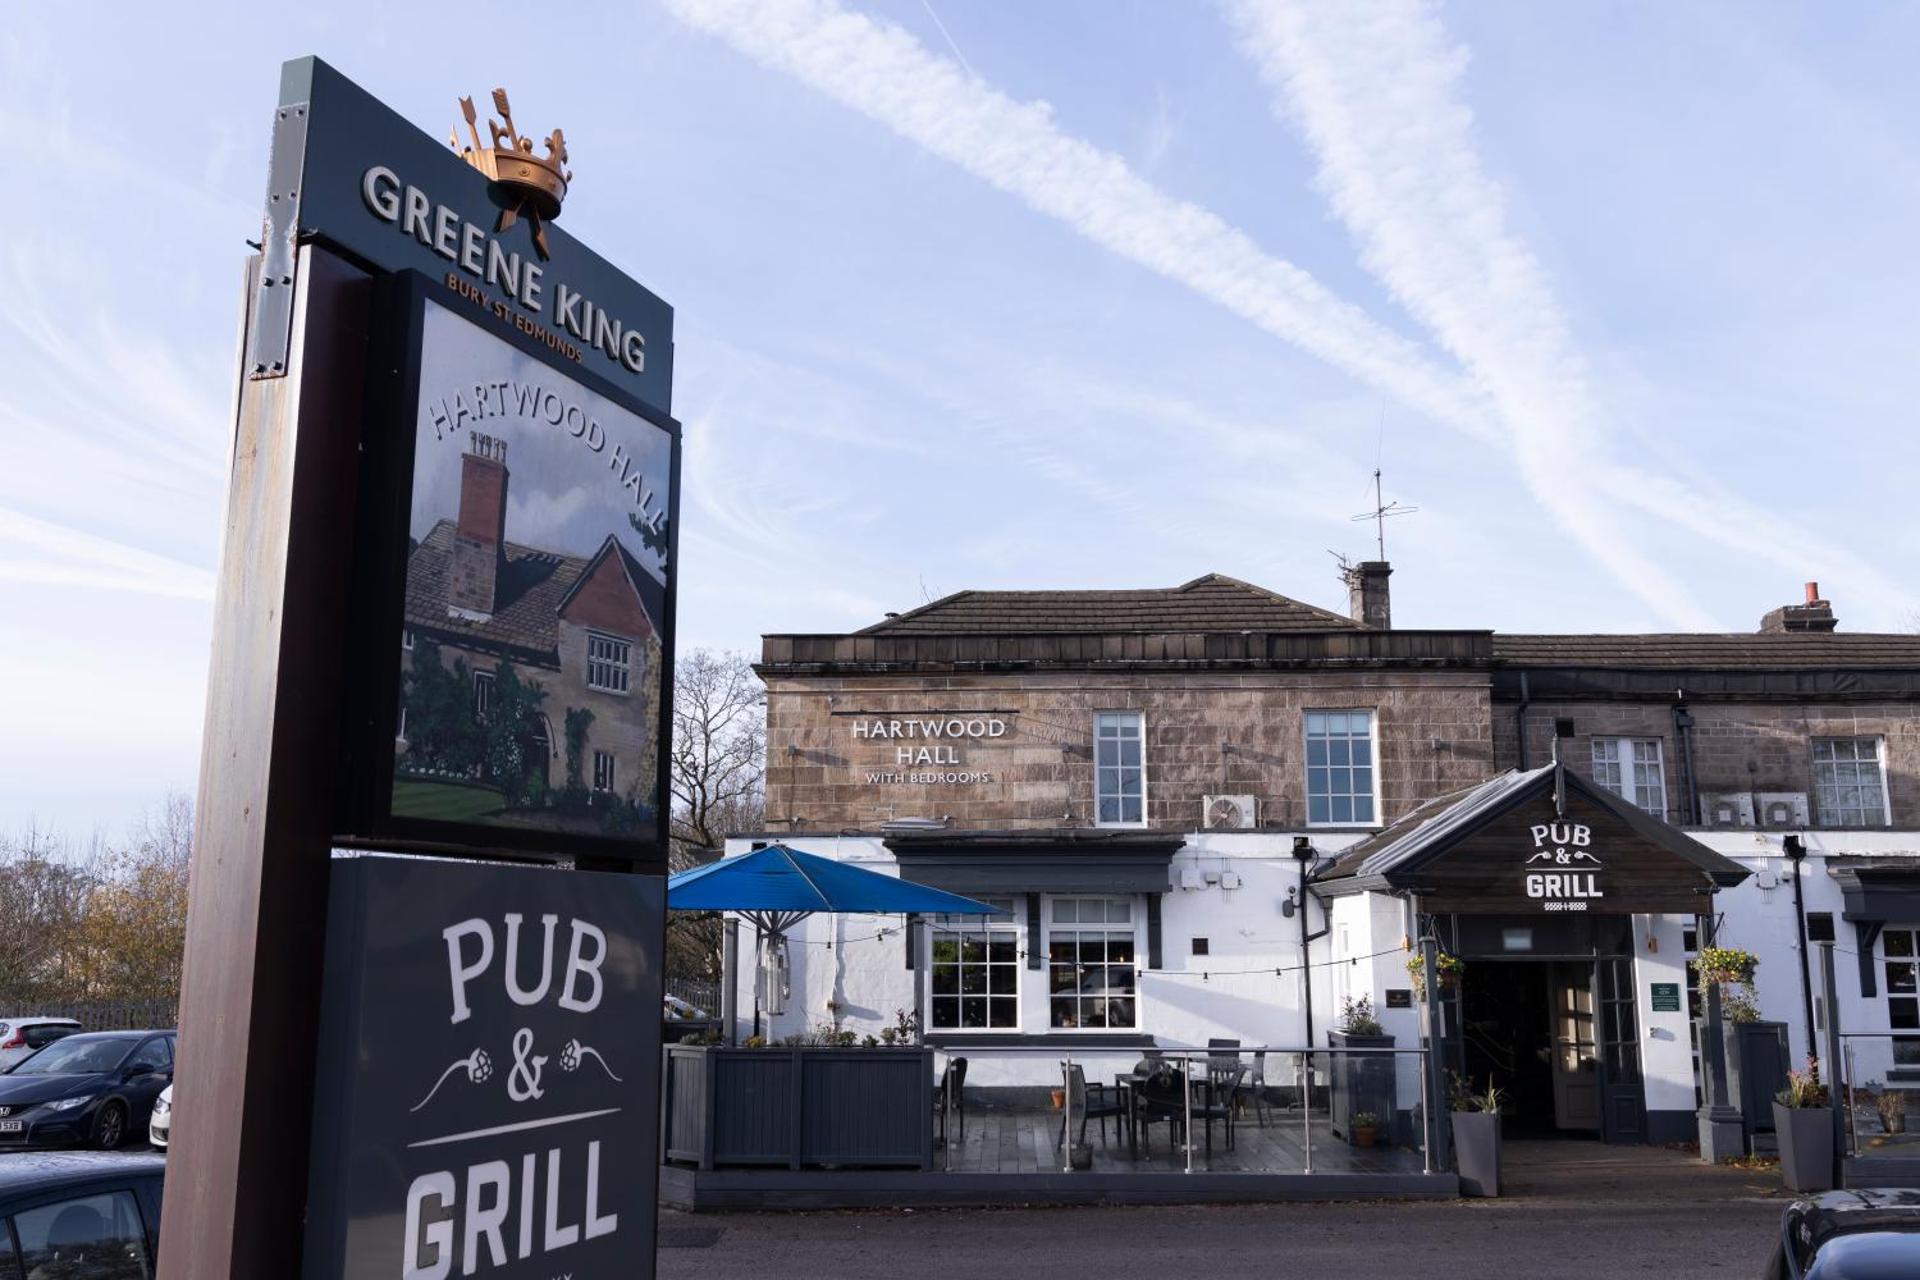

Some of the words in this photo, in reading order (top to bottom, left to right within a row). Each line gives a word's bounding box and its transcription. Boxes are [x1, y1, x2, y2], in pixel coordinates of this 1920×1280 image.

[362, 165, 544, 312] GREENE
[555, 282, 645, 374] KING
[446, 272, 489, 307] BURY
[515, 314, 583, 364] EDMUNDS
[430, 381, 605, 453] HARTWOOD
[608, 444, 664, 535] HALL
[852, 719, 1005, 738] HARTWOOD
[866, 772, 905, 783] WITH
[910, 772, 989, 783] BEDROOMS
[897, 746, 960, 764] HALL
[1530, 823, 1591, 847] PUB
[1555, 847, 1571, 864] &
[1526, 874, 1604, 898] GRILL
[442, 913, 608, 1024] PUB
[507, 1027, 549, 1102] &
[402, 1140, 618, 1280] GRILL
